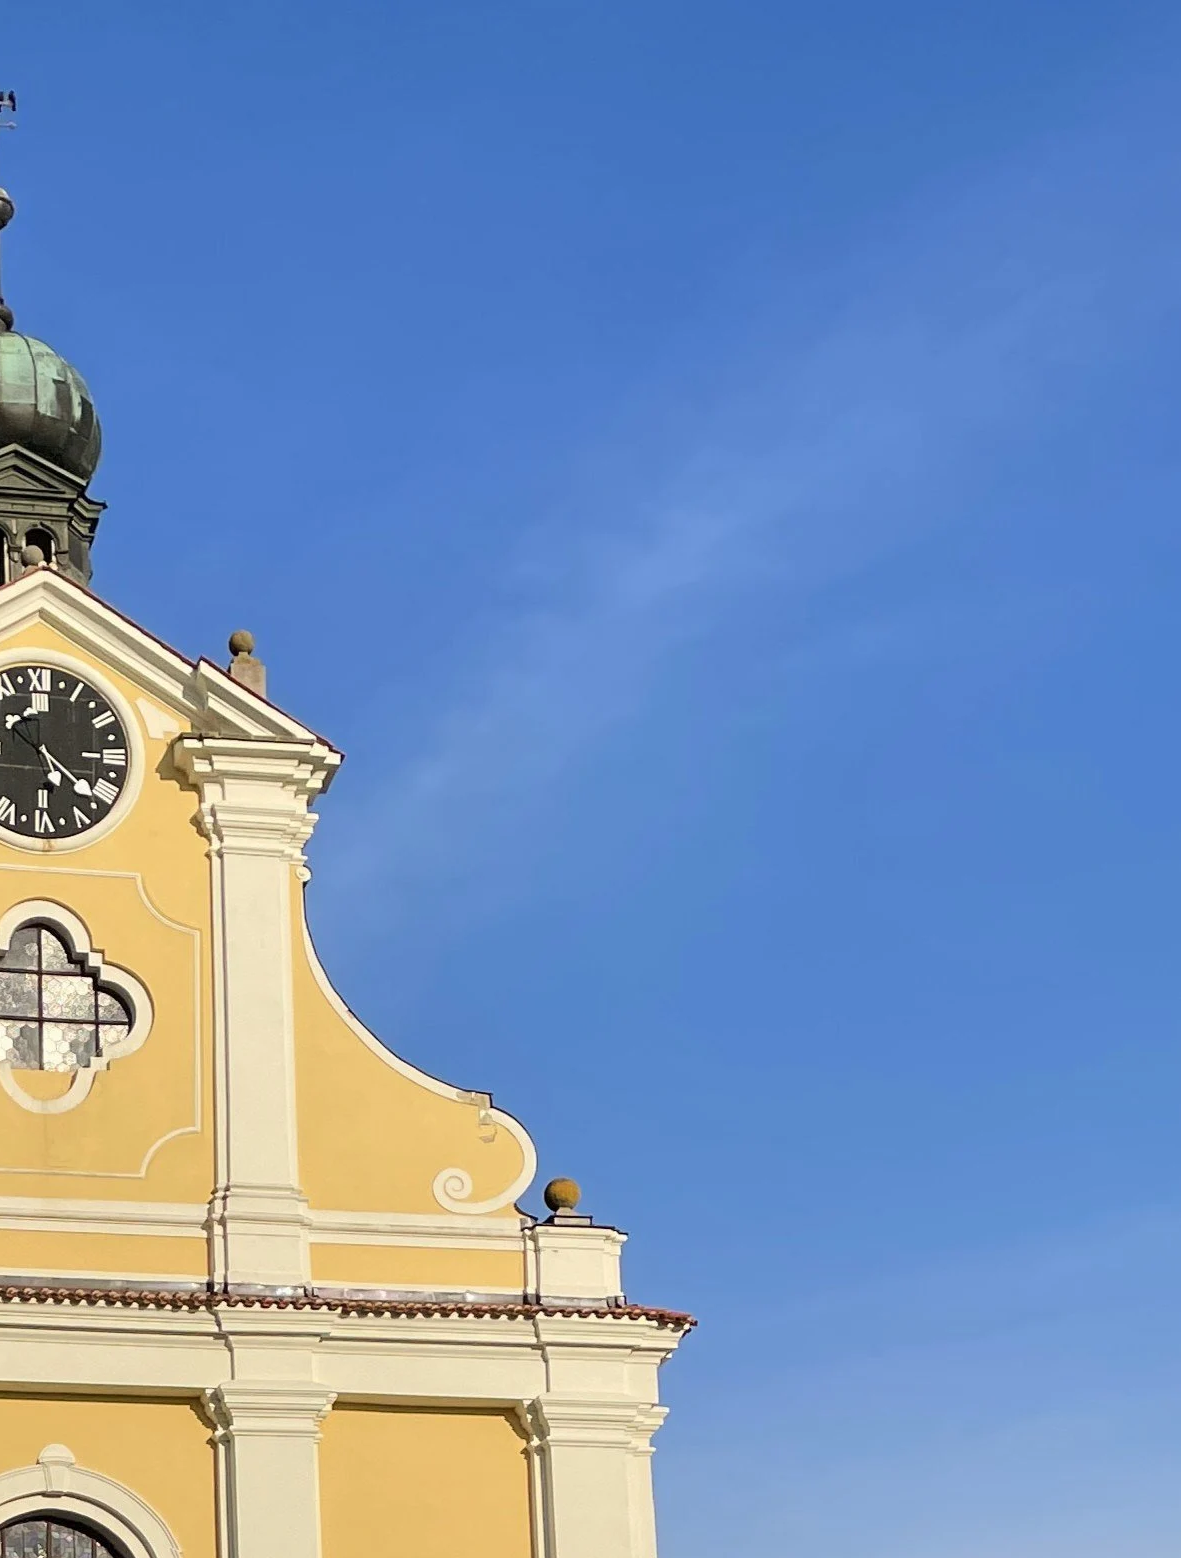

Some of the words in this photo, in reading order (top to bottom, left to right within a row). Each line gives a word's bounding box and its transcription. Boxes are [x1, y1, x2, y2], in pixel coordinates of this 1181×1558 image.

[28, 668, 51, 691] XII
[69, 682, 84, 702] I
[91, 710, 116, 729] II
[102, 748, 126, 766] III
[37, 788, 48, 809] II
[34, 809, 55, 833] VI
[72, 805, 91, 828] V
